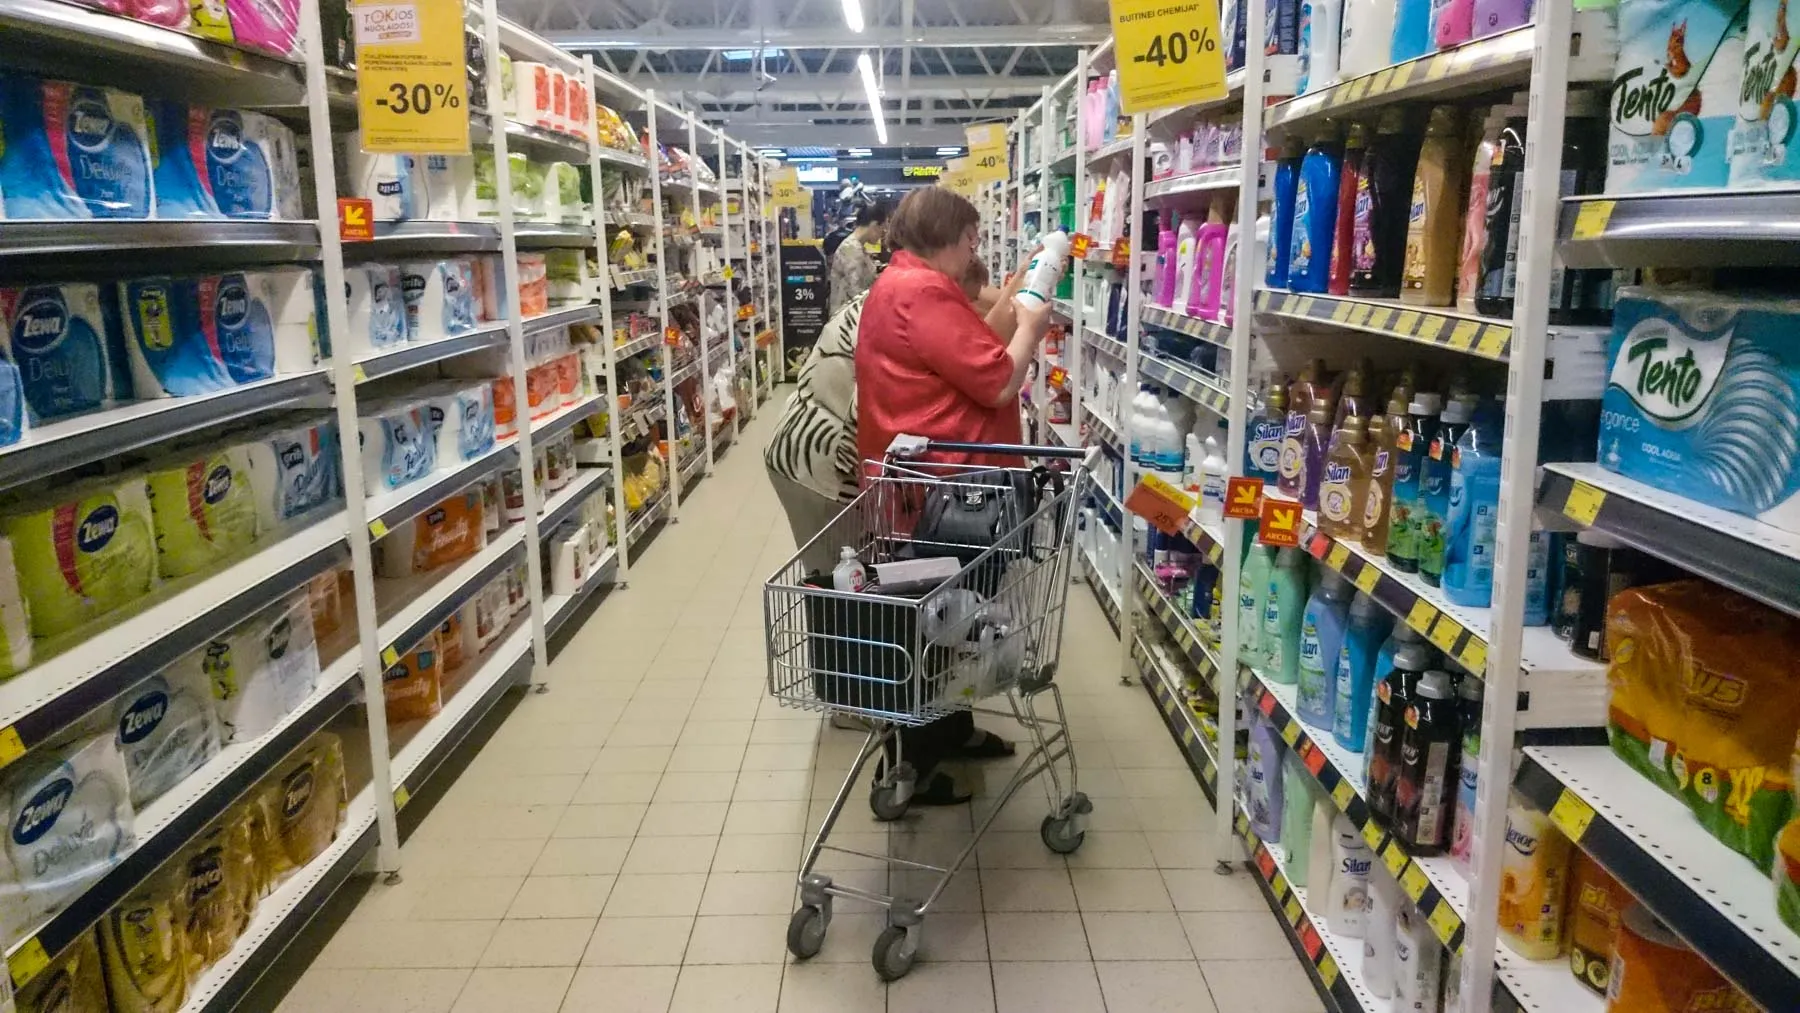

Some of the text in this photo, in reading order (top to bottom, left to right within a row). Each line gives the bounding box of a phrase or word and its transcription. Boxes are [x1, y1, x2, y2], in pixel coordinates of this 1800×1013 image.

[1120, 11, 1156, 23] BUITINEI
[1133, 26, 1216, 68] -40%
[375, 82, 460, 116] -30%
[1611, 66, 1677, 125] Tento
[794, 288, 815, 301] 3%
[22, 314, 61, 338] Zewa
[1627, 337, 1702, 409] Tento
[1255, 423, 1284, 441] Silan
[1325, 462, 1351, 481] Silan
[83, 517, 115, 544] Zewa
[123, 700, 164, 735] Zewa
[1701, 771, 1714, 786] 8
[21, 790, 67, 835] Zewa
[1341, 857, 1372, 874] Silan
